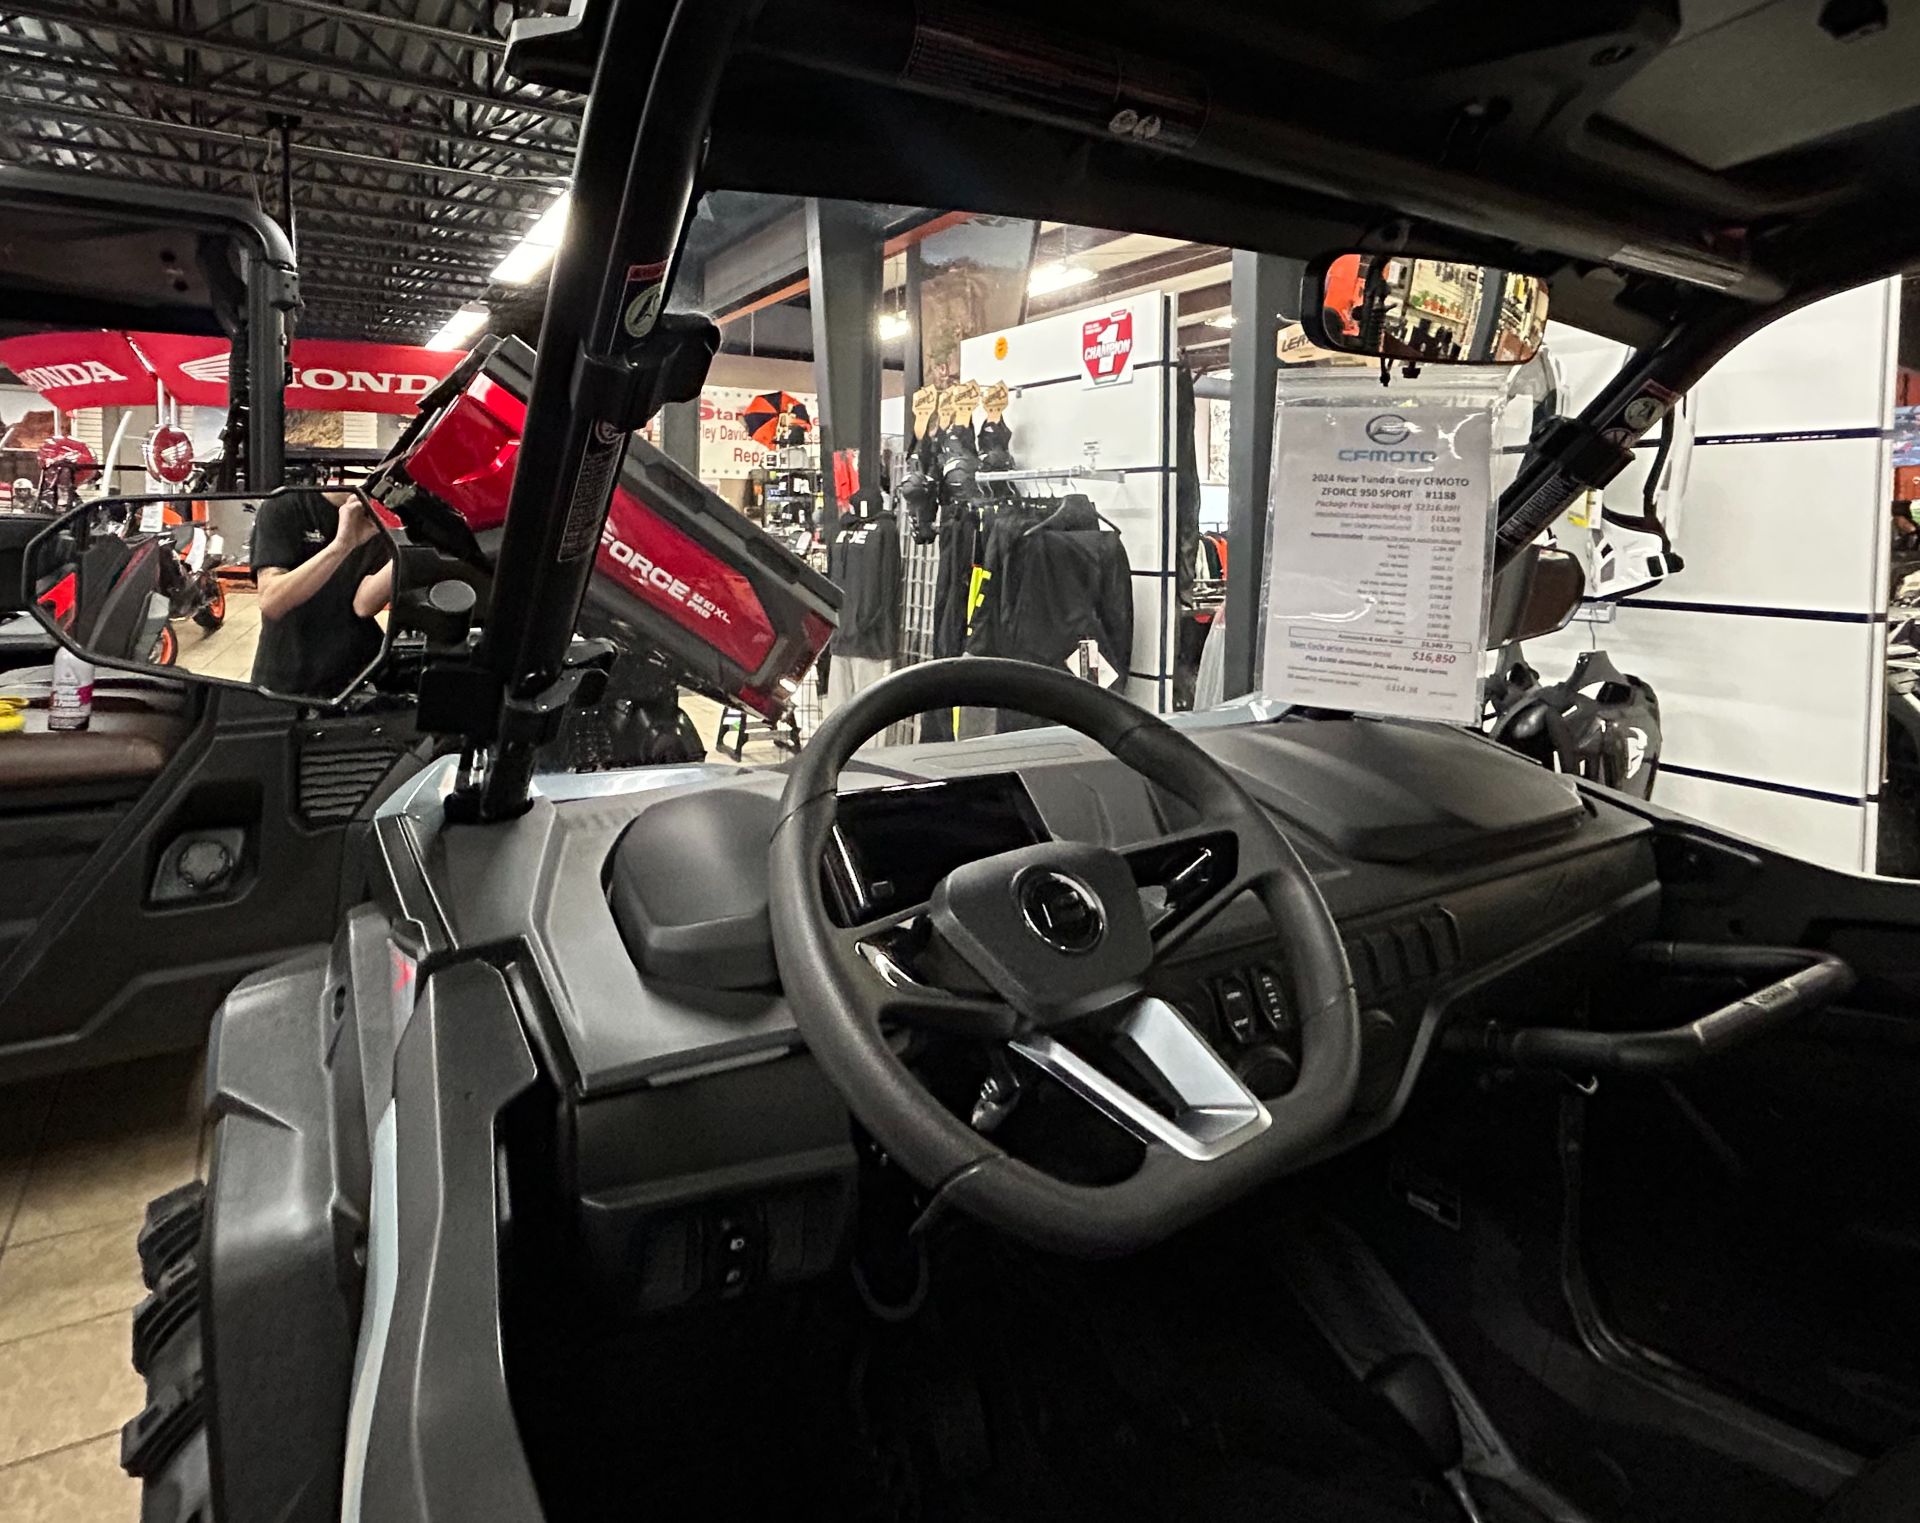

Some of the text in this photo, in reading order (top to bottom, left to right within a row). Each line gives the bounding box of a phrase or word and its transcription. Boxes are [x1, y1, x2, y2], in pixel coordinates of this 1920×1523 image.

[1084, 338, 1131, 361] CHAMPION
[285, 368, 438, 395] OND
[1338, 450, 1437, 463] CFMOTO
[1312, 474, 1469, 487] 2024 New Tundra Grey CFMOTO
[1321, 487, 1357, 497] ZFORCE
[1360, 488, 1378, 497] 950
[1379, 489, 1413, 498] SPORT
[1411, 652, 1457, 664] $16,850
